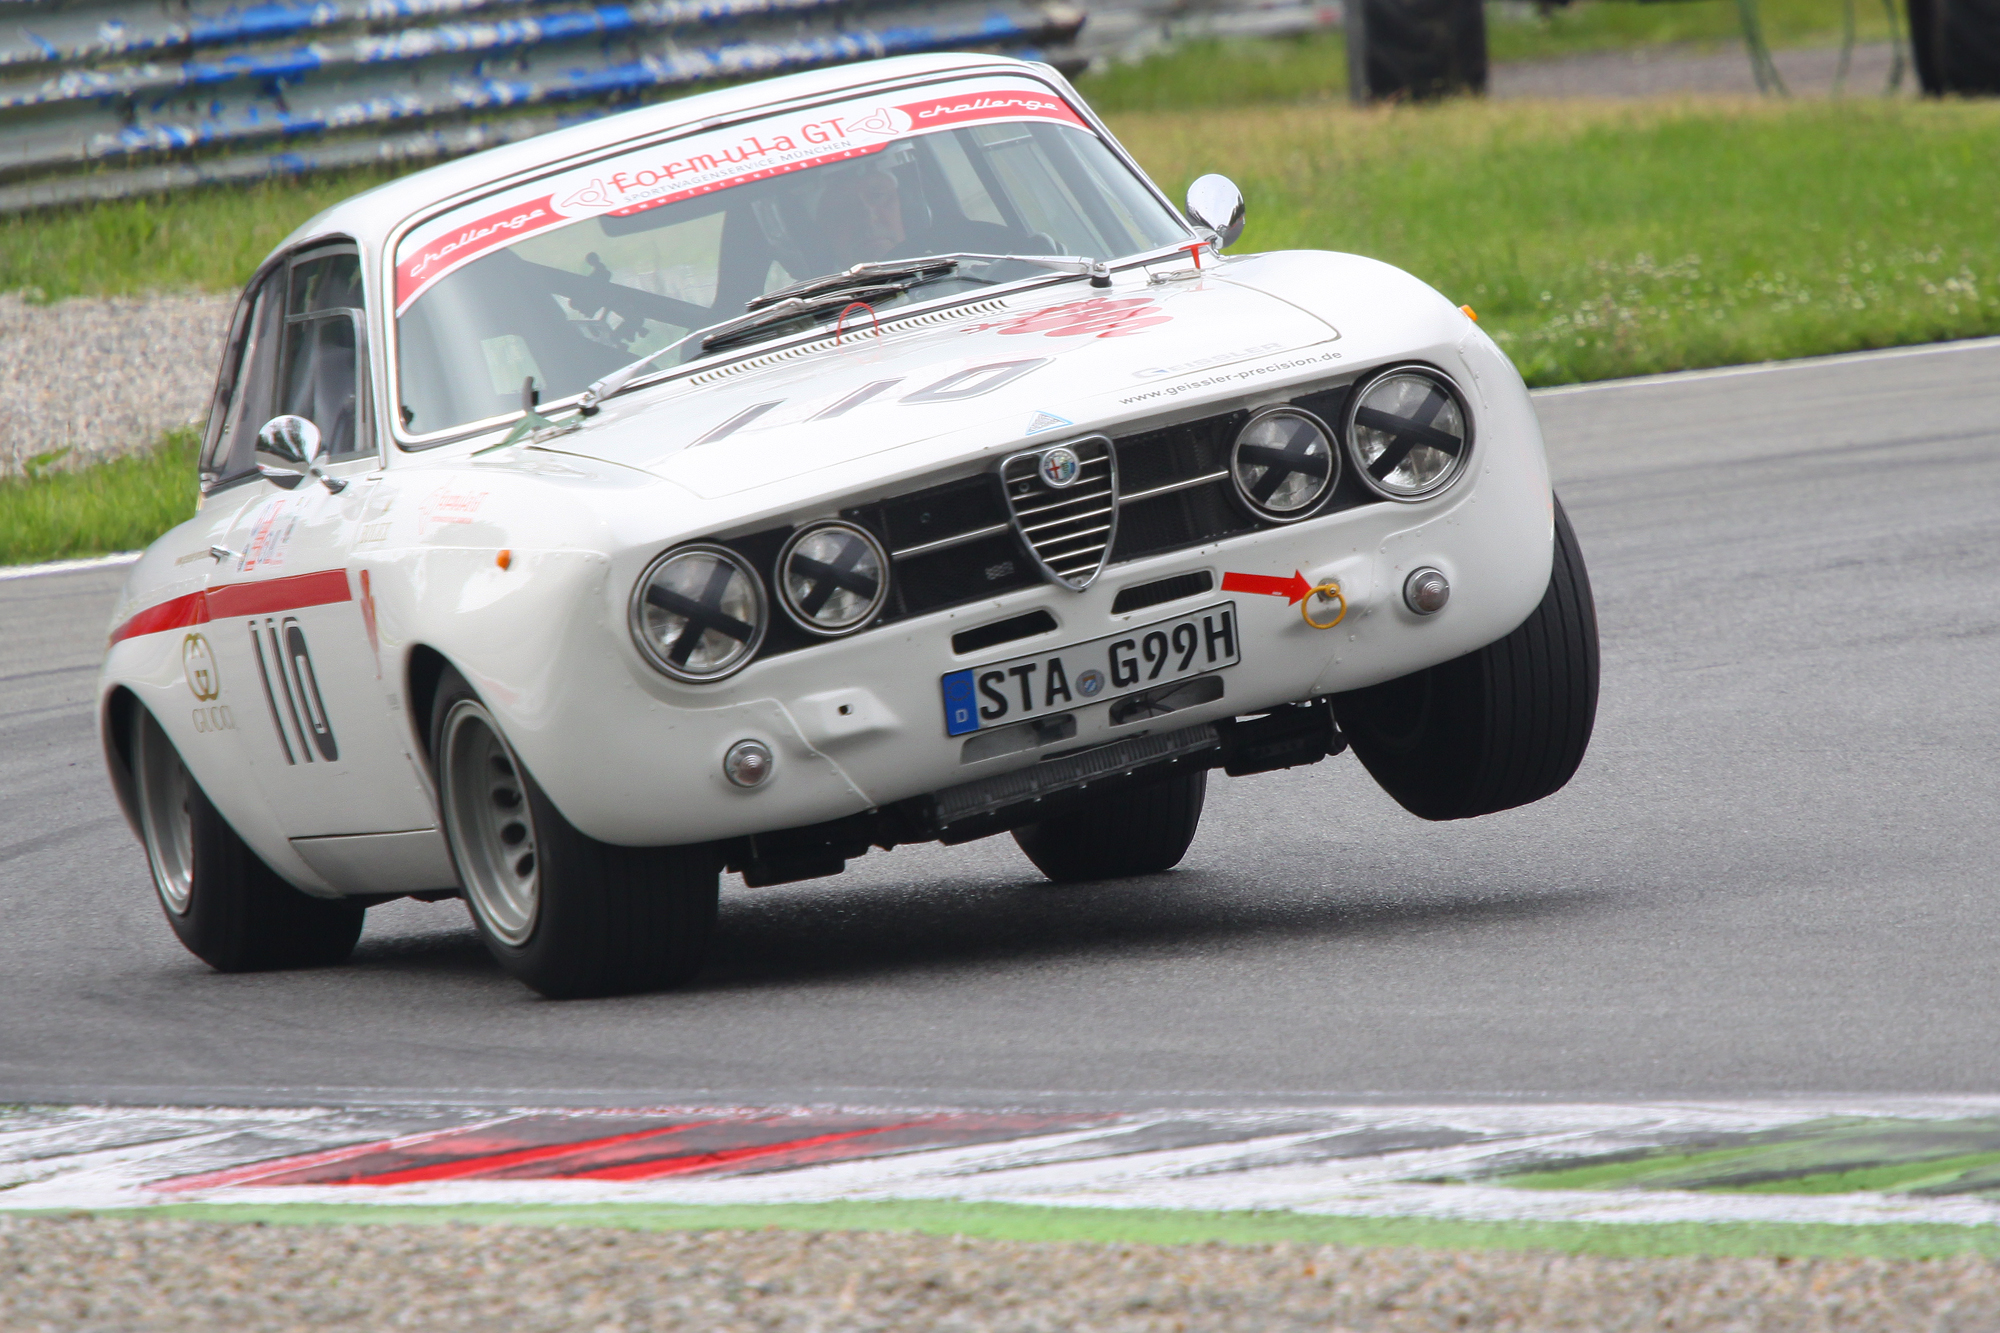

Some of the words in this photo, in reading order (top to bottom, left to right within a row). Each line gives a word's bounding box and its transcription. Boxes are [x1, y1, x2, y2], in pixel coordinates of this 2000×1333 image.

[918, 97, 1059, 119] challenge
[608, 136, 797, 194] formula
[800, 117, 846, 144] GT
[624, 157, 776, 203] SPORTWAGENSERVICE
[780, 140, 852, 163] MÜNCHEN
[410, 208, 548, 278] challenge
[1118, 350, 1343, 405] www.geissler-precision.de
[247, 616, 339, 766] 110
[977, 656, 1073, 721] STA
[1107, 610, 1235, 689] G99H
[955, 708, 969, 724] D
